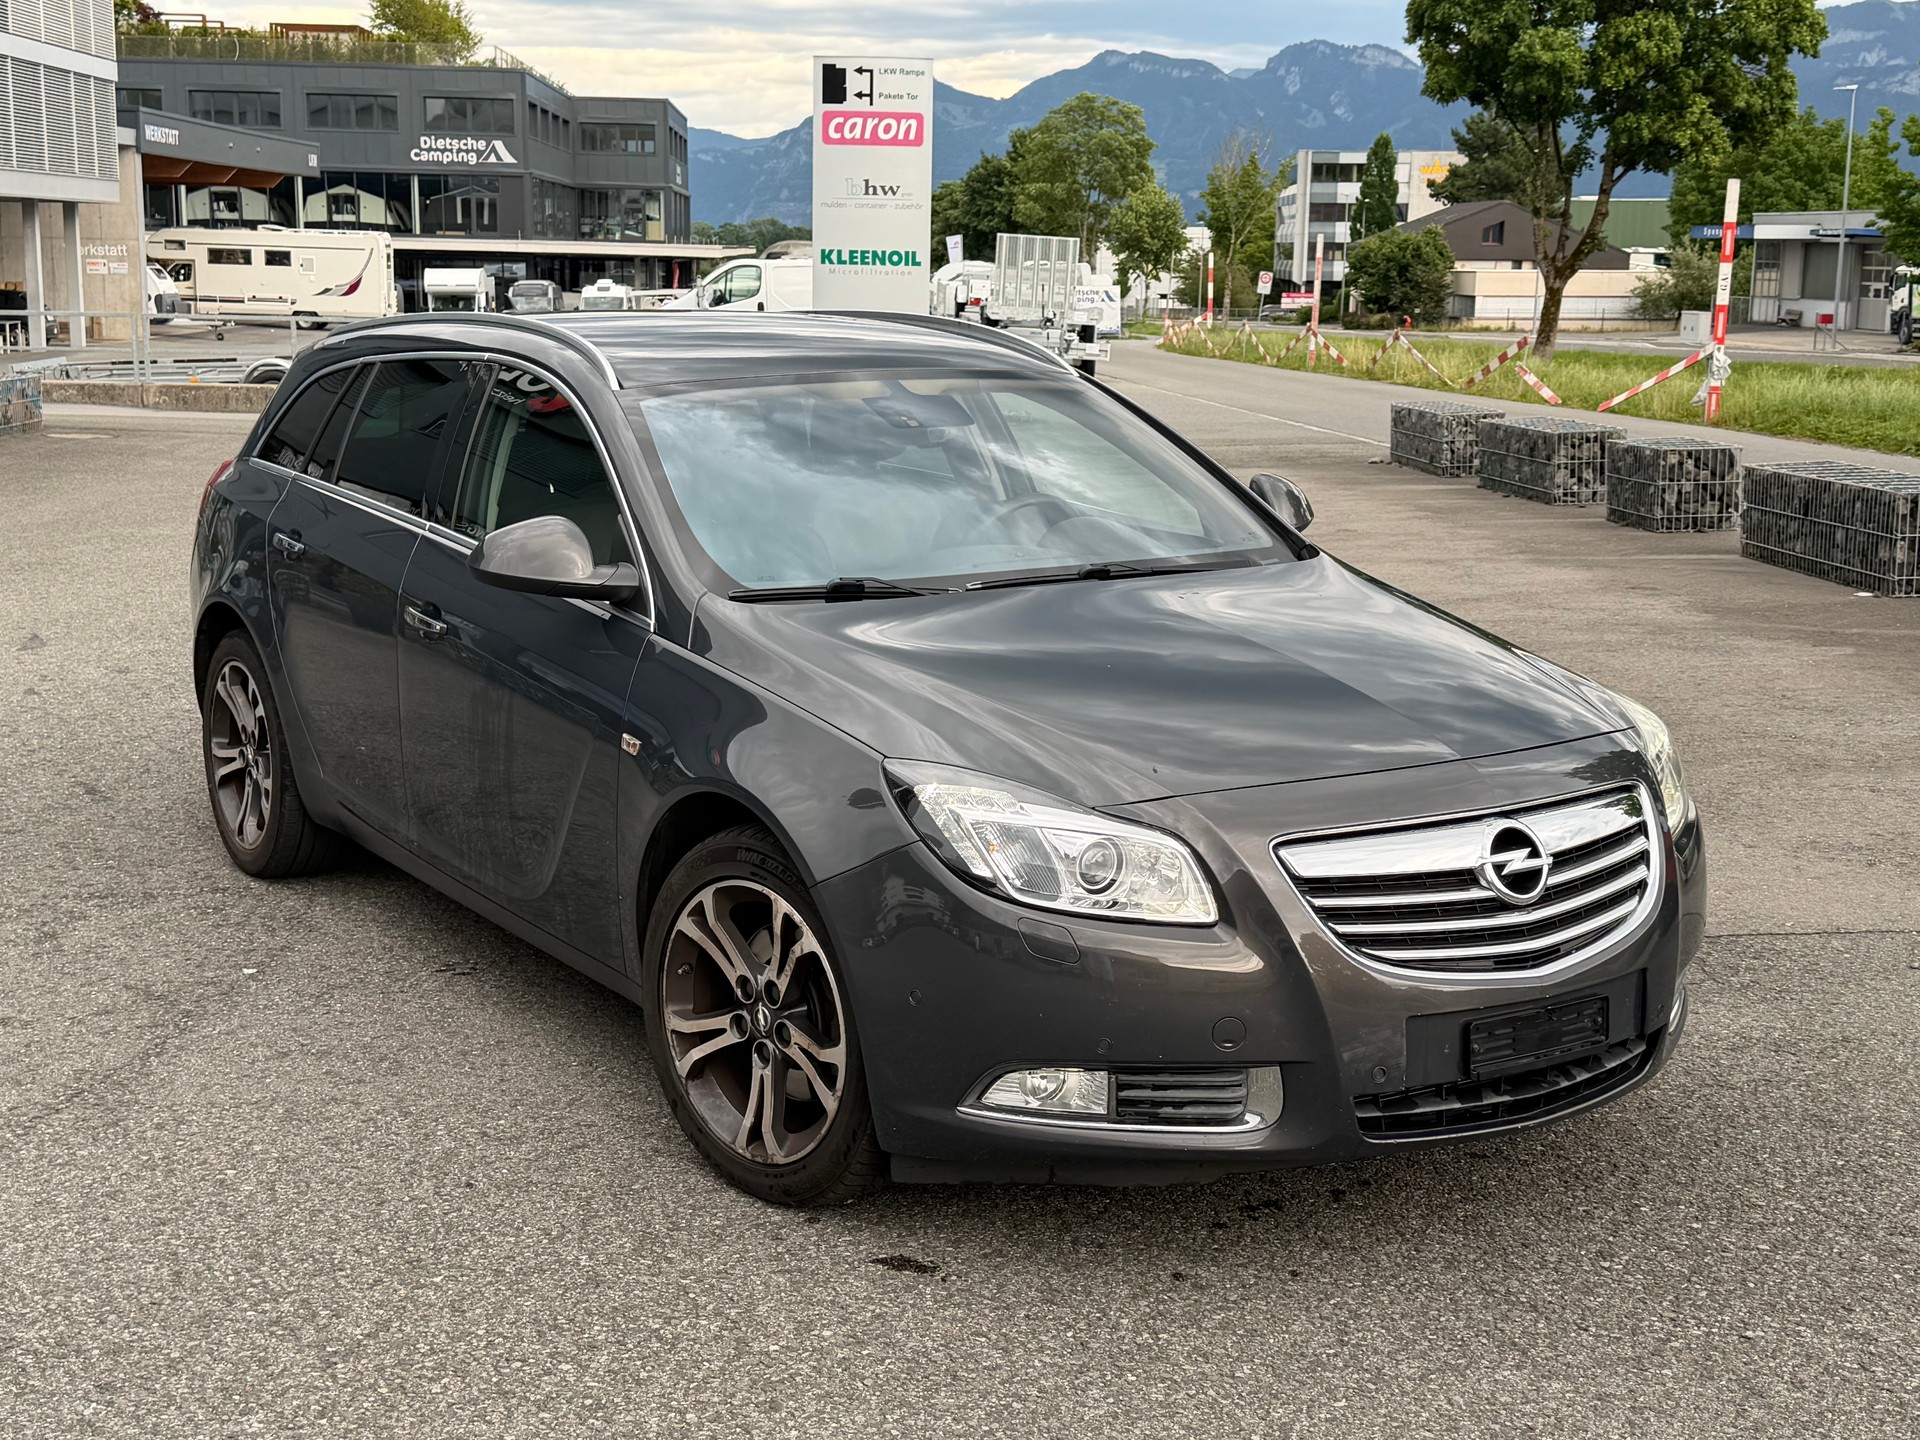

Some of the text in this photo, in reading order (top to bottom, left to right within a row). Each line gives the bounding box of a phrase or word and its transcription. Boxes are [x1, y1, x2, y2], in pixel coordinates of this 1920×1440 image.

[878, 67, 926, 77] LKW Rampe
[878, 92, 919, 100] Pakete Tor
[828, 116, 918, 140] caron
[144, 124, 179, 146] WERKSTATT
[420, 136, 486, 150] Dietsche
[410, 148, 478, 165] Camping
[844, 177, 901, 196] bhw
[820, 201, 924, 210] mulden container zubehör
[1703, 226, 1740, 237] Spengi
[80, 243, 128, 256] erkstatt
[820, 248, 922, 267] KLEENOIL
[828, 267, 912, 276] Microfiltration
